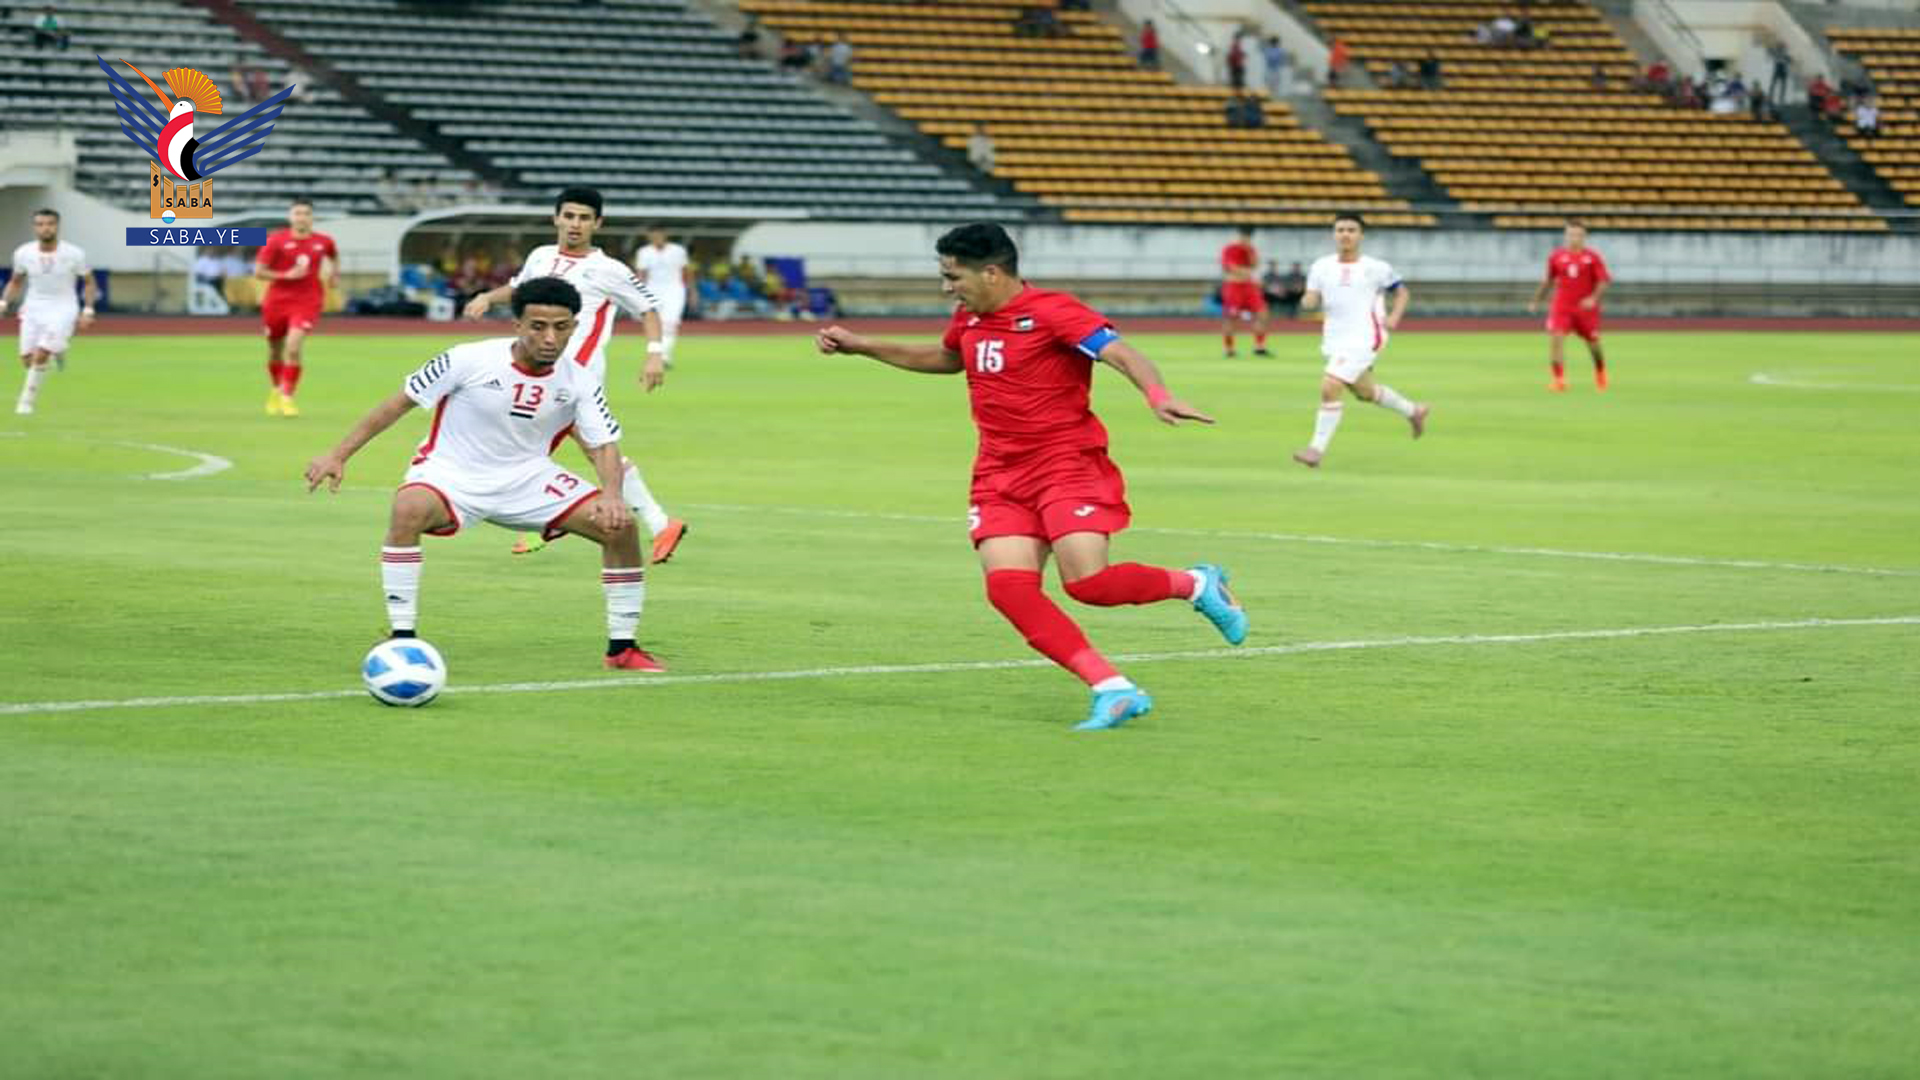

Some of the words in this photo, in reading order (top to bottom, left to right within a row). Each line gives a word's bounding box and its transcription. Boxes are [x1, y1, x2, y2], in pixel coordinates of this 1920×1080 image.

[551, 257, 577, 274] 17
[975, 339, 1005, 373] 15
[512, 383, 543, 406] 13
[544, 473, 579, 498] 13
